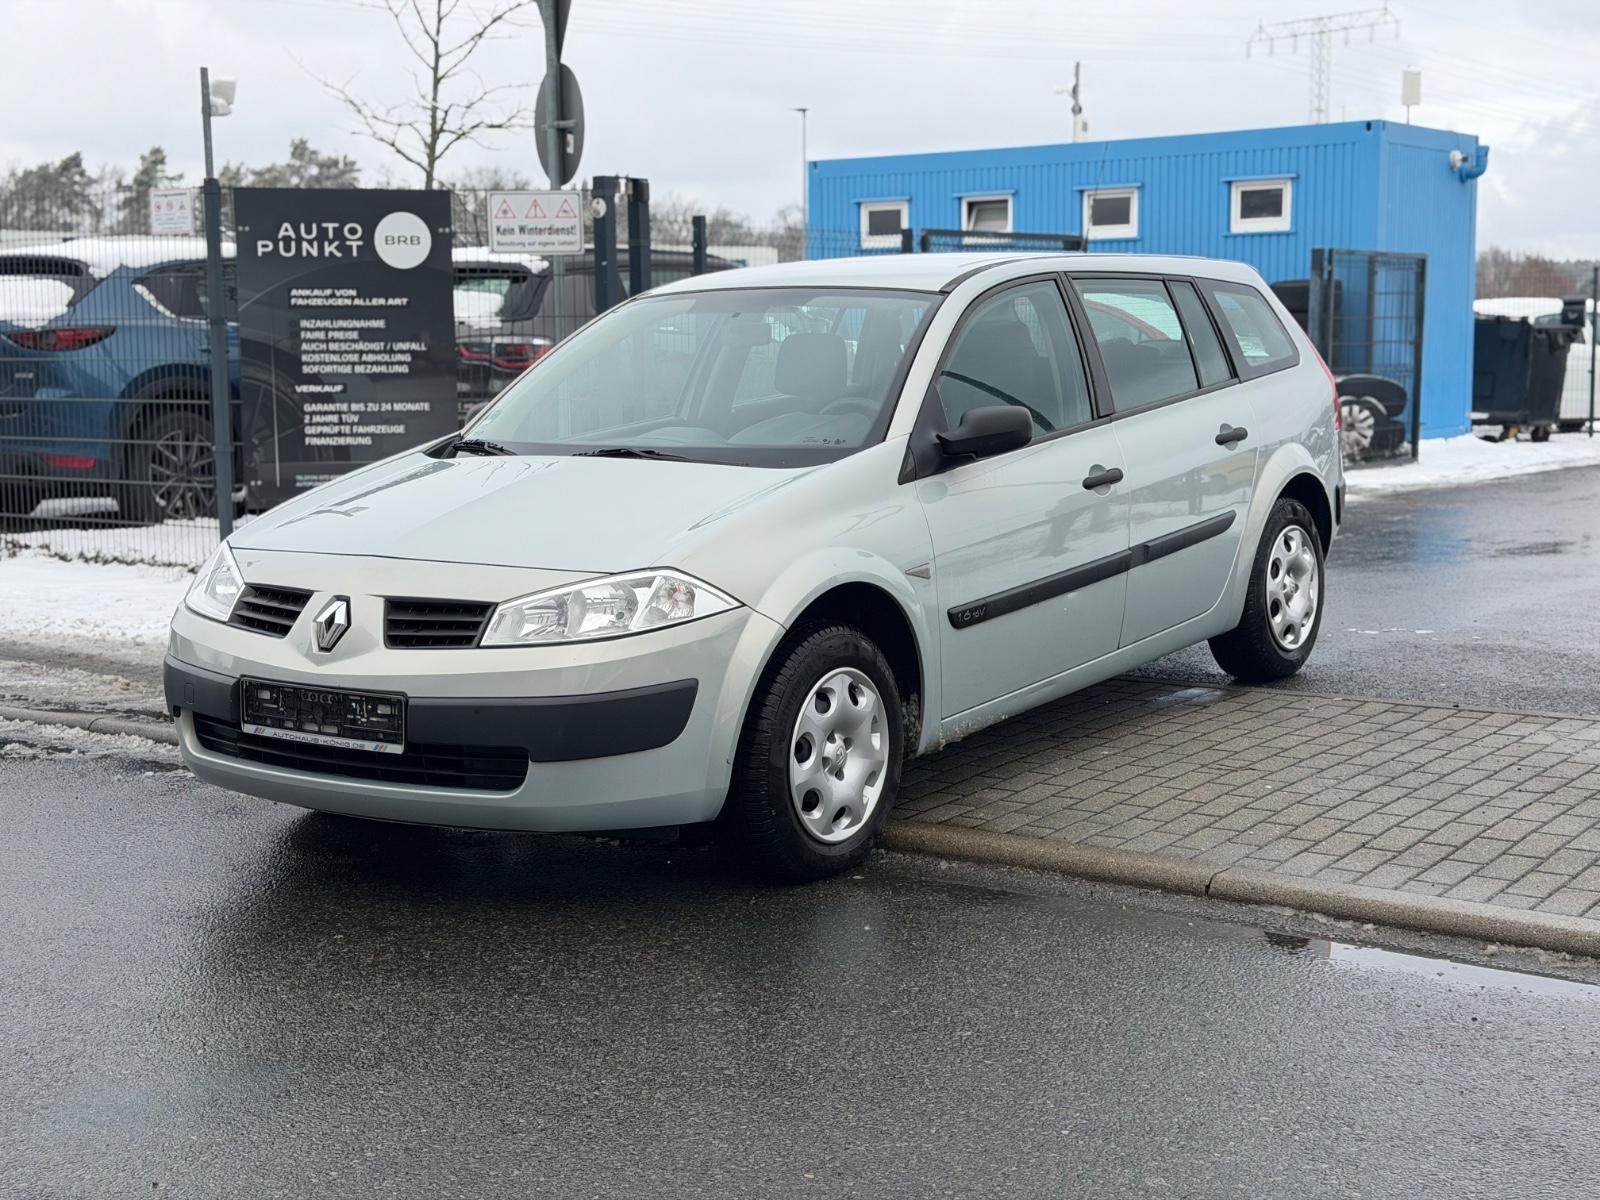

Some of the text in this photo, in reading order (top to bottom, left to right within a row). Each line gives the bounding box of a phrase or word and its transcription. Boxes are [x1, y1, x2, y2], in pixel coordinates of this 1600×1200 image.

[277, 222, 363, 239] AUTO
[496, 225, 577, 236] Kein Winterdienst!
[384, 235, 421, 246] BRB
[256, 240, 364, 257] PUNKT
[352, 298, 386, 306] ALLER
[386, 298, 408, 306] ART
[300, 319, 386, 329] INZAHLUNGNAHME
[300, 331, 359, 340] FAIRE PREISE
[301, 342, 326, 351] AUCH
[328, 340, 385, 351] BESCHÄDIGT
[392, 342, 427, 351] UNFALL
[301, 353, 412, 362] KOSTENLOSE ABHOLUNG
[302, 364, 409, 374] SOFORTIGE BEZAHLUNG
[295, 385, 344, 393] VERKAUF
[303, 402, 430, 412] GARANTIE BIS ZU 24 MONATE
[304, 412, 360, 423] 2 JAHRE TÜV
[304, 424, 405, 434] GEPRÜFTE FAHRZEUGE
[305, 437, 372, 446] FINANZIERUNG
